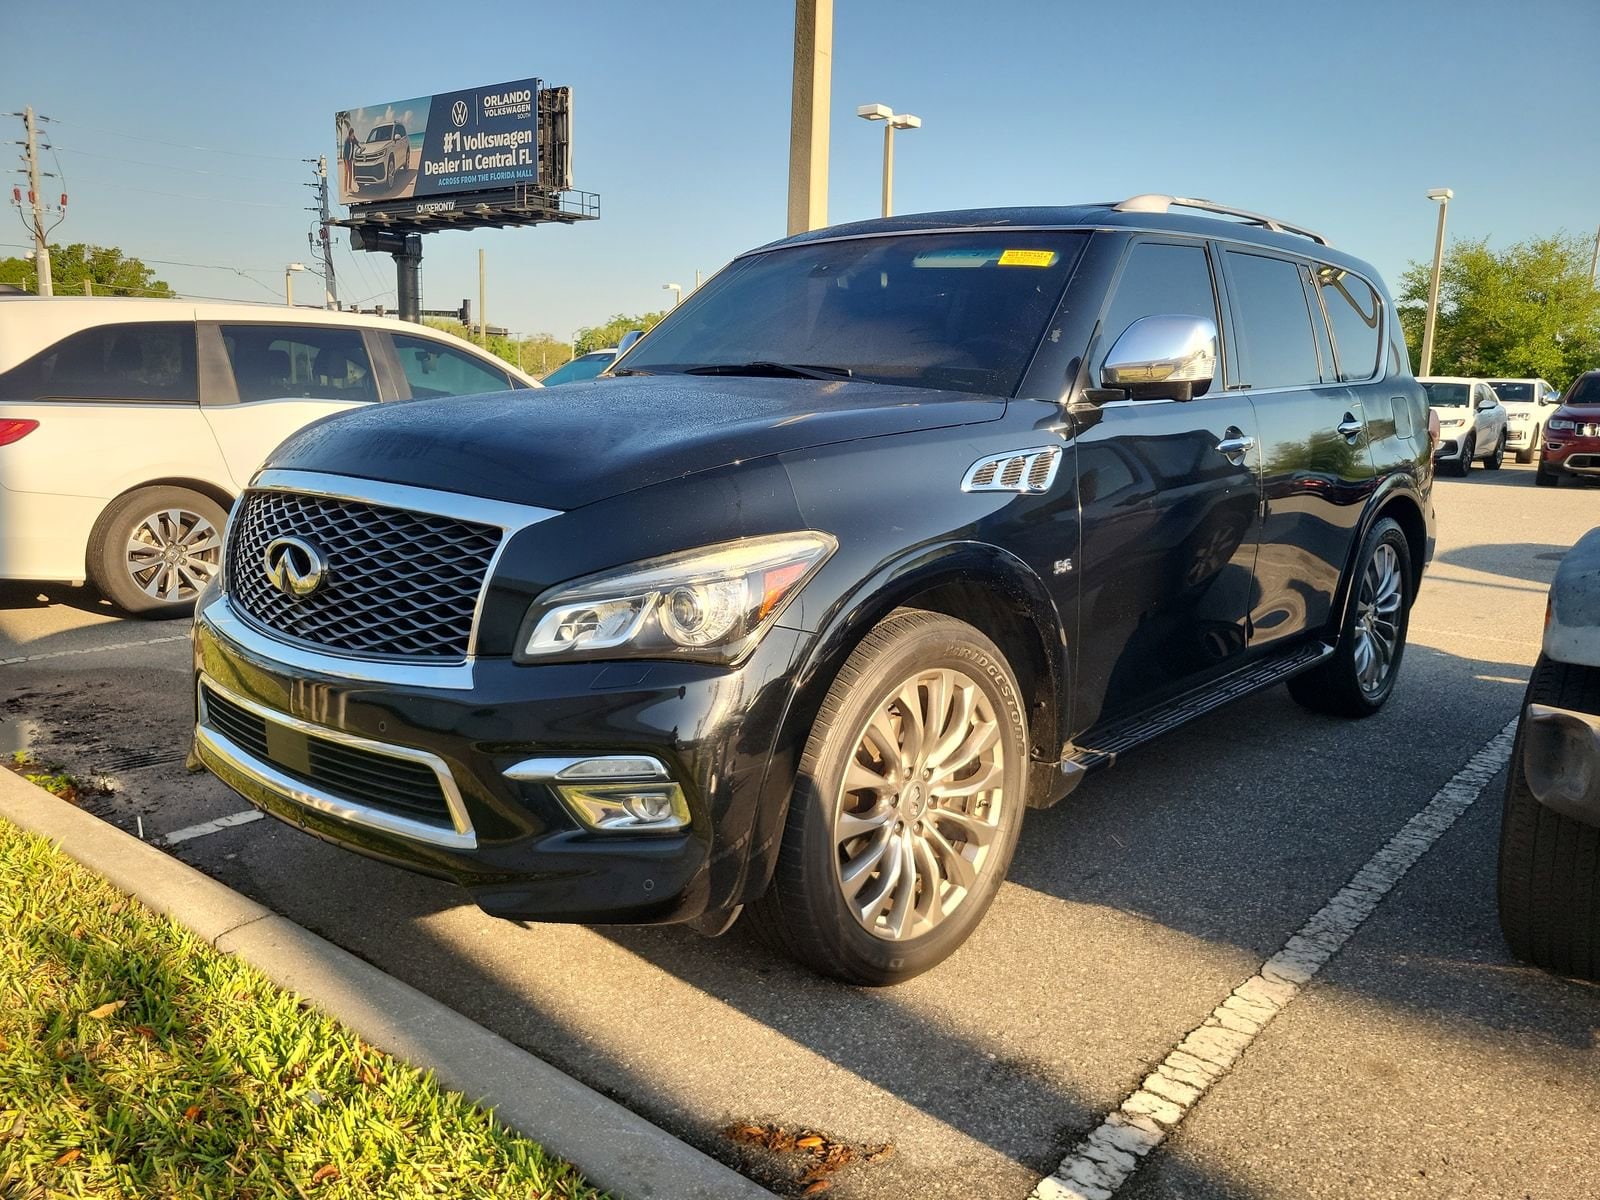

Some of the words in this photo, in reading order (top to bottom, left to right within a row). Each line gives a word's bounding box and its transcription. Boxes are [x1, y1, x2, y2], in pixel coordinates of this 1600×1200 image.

[484, 90, 531, 107] ORLANDO
[484, 104, 531, 117] VOLKSWAGEN
[443, 131, 461, 153] #1
[463, 130, 532, 151] Volkswagen
[424, 158, 460, 176] Dealer
[462, 154, 473, 171] in
[475, 149, 517, 170] Central
[519, 148, 533, 165] FL
[438, 177, 460, 186] ACROSS
[460, 176, 477, 184] FROM
[478, 173, 489, 182] THE
[490, 171, 515, 180] FLORIDA
[516, 169, 533, 178] MALL
